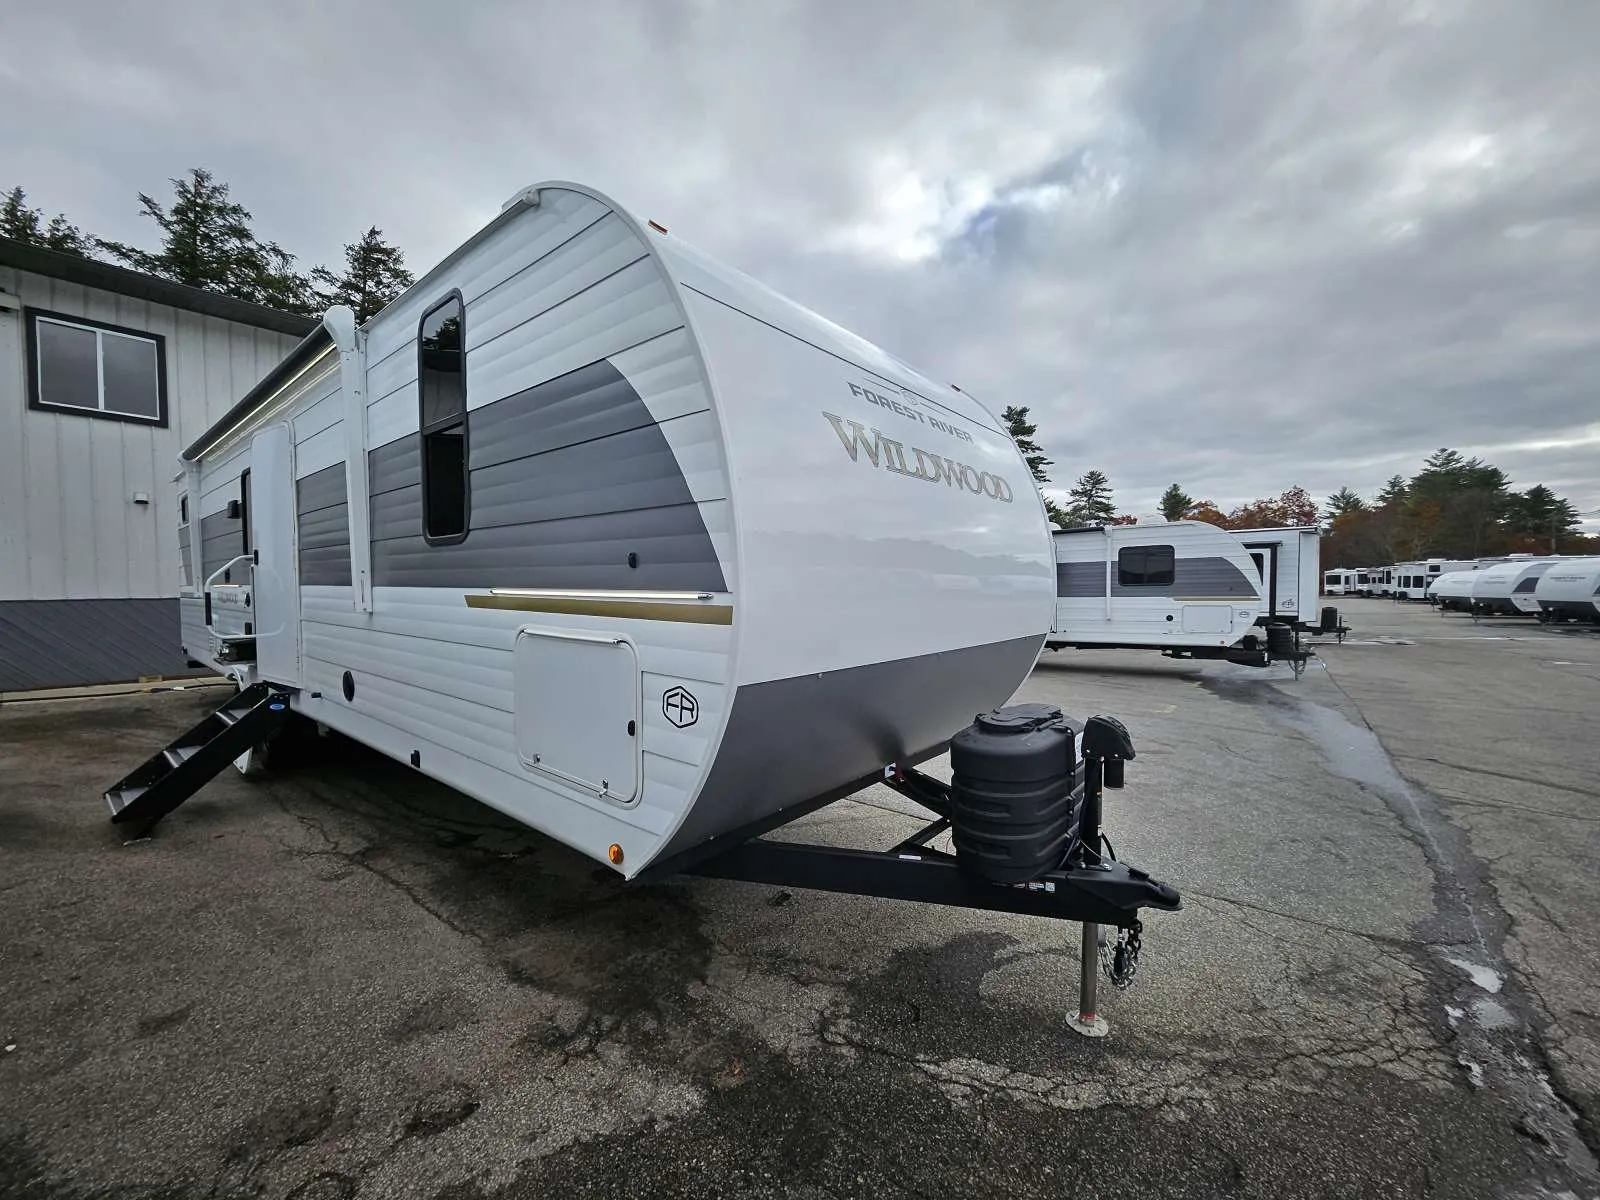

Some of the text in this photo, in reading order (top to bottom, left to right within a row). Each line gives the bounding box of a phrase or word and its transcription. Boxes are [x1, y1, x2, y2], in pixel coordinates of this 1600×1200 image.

[846, 381, 974, 444] FOREST RIVER
[822, 410, 1014, 504] WILDWOOD
